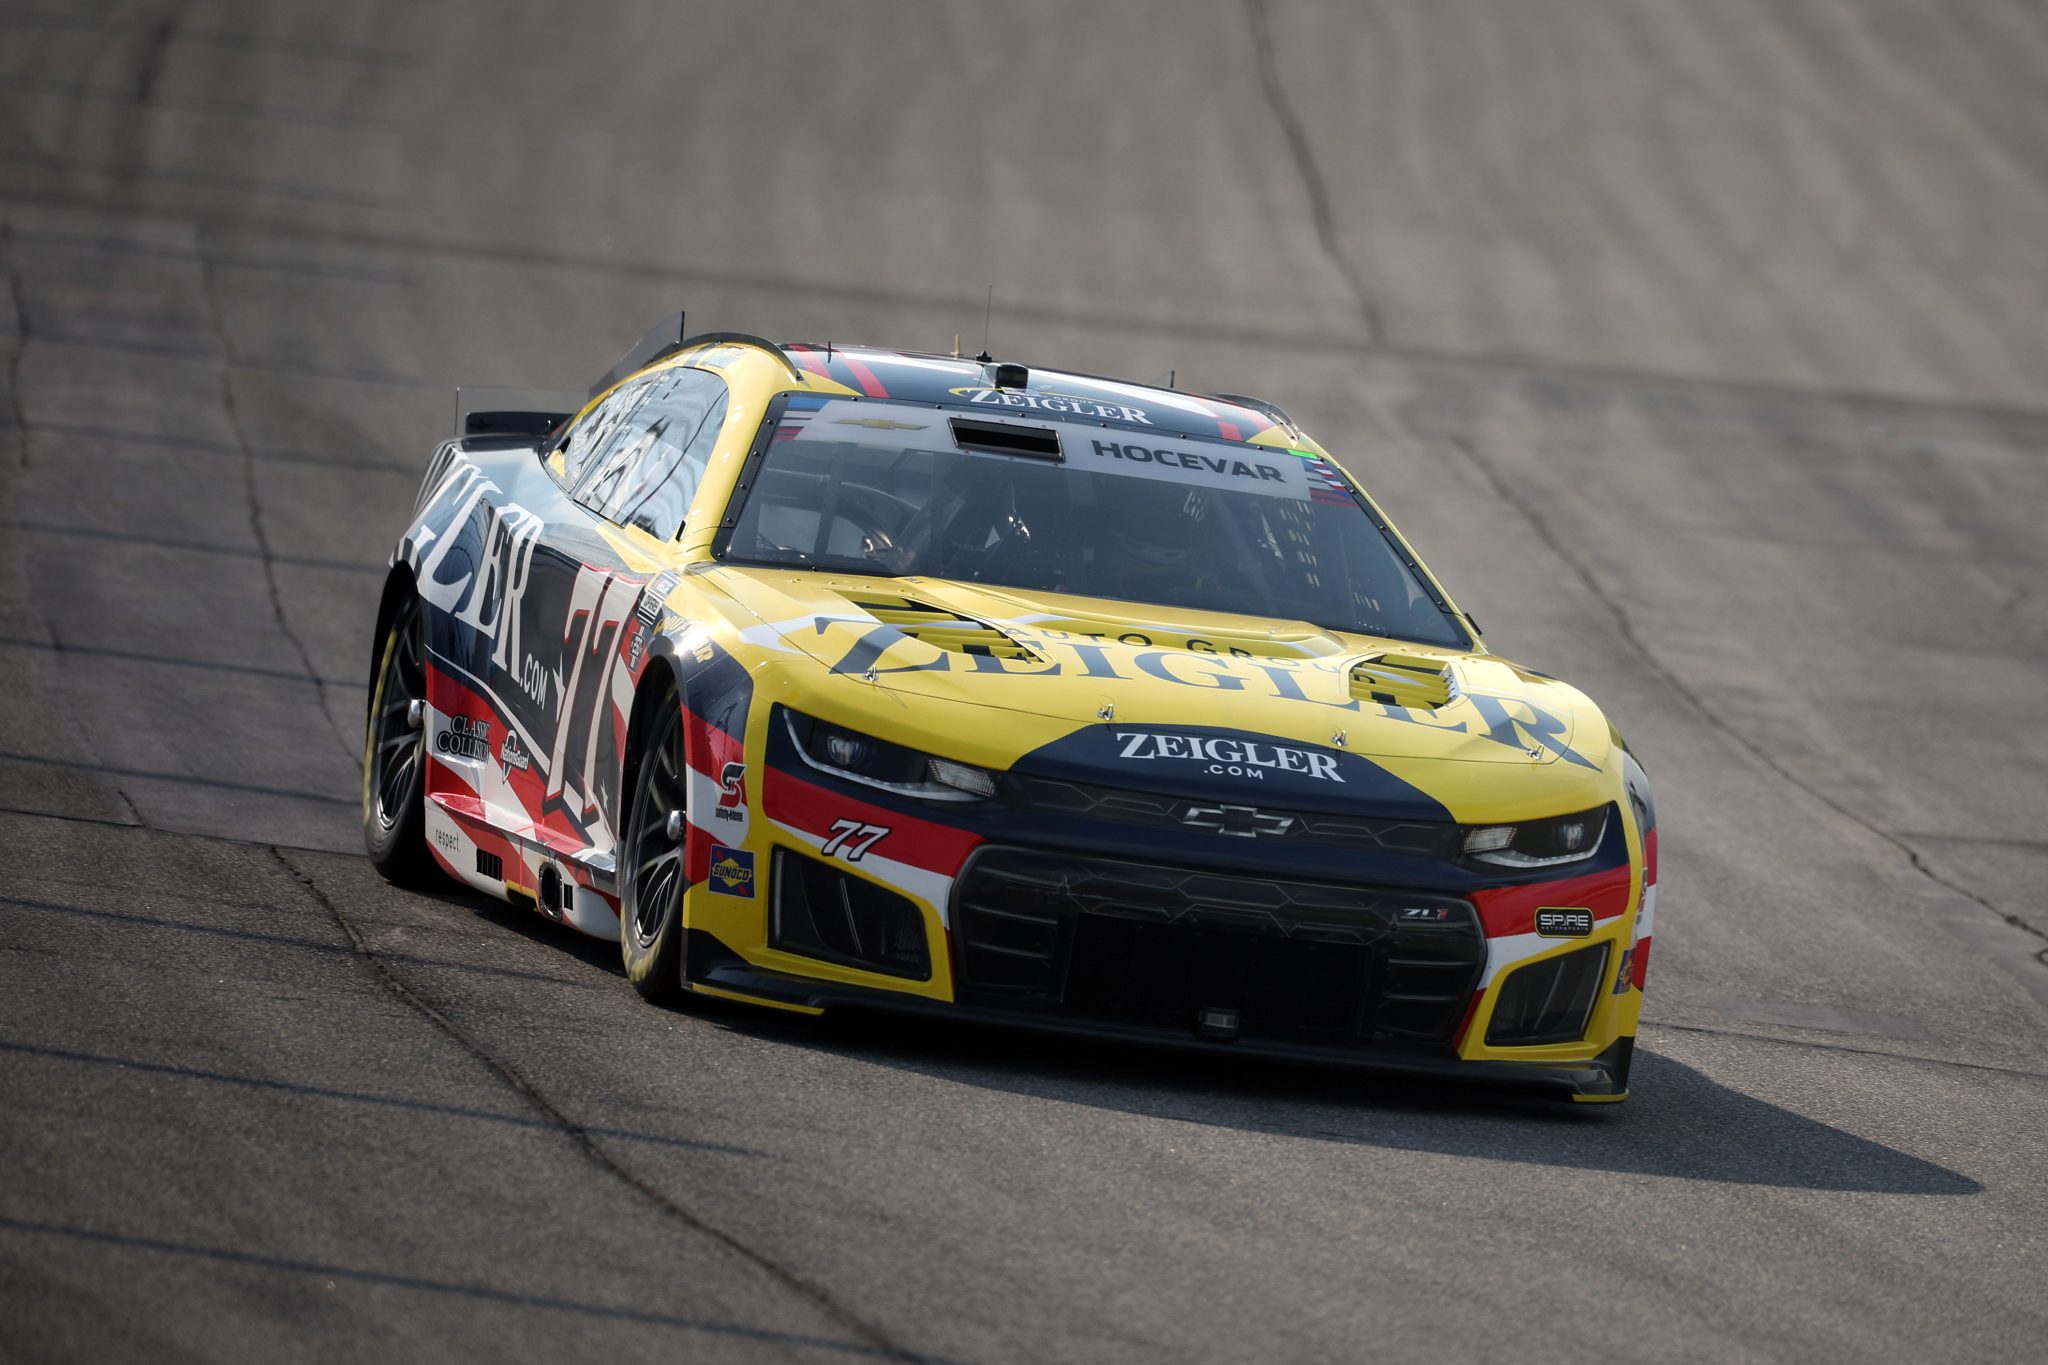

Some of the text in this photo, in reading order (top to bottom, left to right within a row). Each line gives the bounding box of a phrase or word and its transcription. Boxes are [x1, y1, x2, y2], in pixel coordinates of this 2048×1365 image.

[967, 389, 1153, 425] ZEIGLER
[1091, 439, 1287, 484] HOCEVAR
[546, 561, 646, 813] 77
[814, 617, 1603, 773] ZEIGLER
[1115, 732, 1346, 784] ZEIGLER
[1203, 764, 1264, 781] .COM
[821, 817, 891, 861] 77
[713, 864, 750, 881] SUNOCO
[1540, 913, 1589, 927] SPIRE
